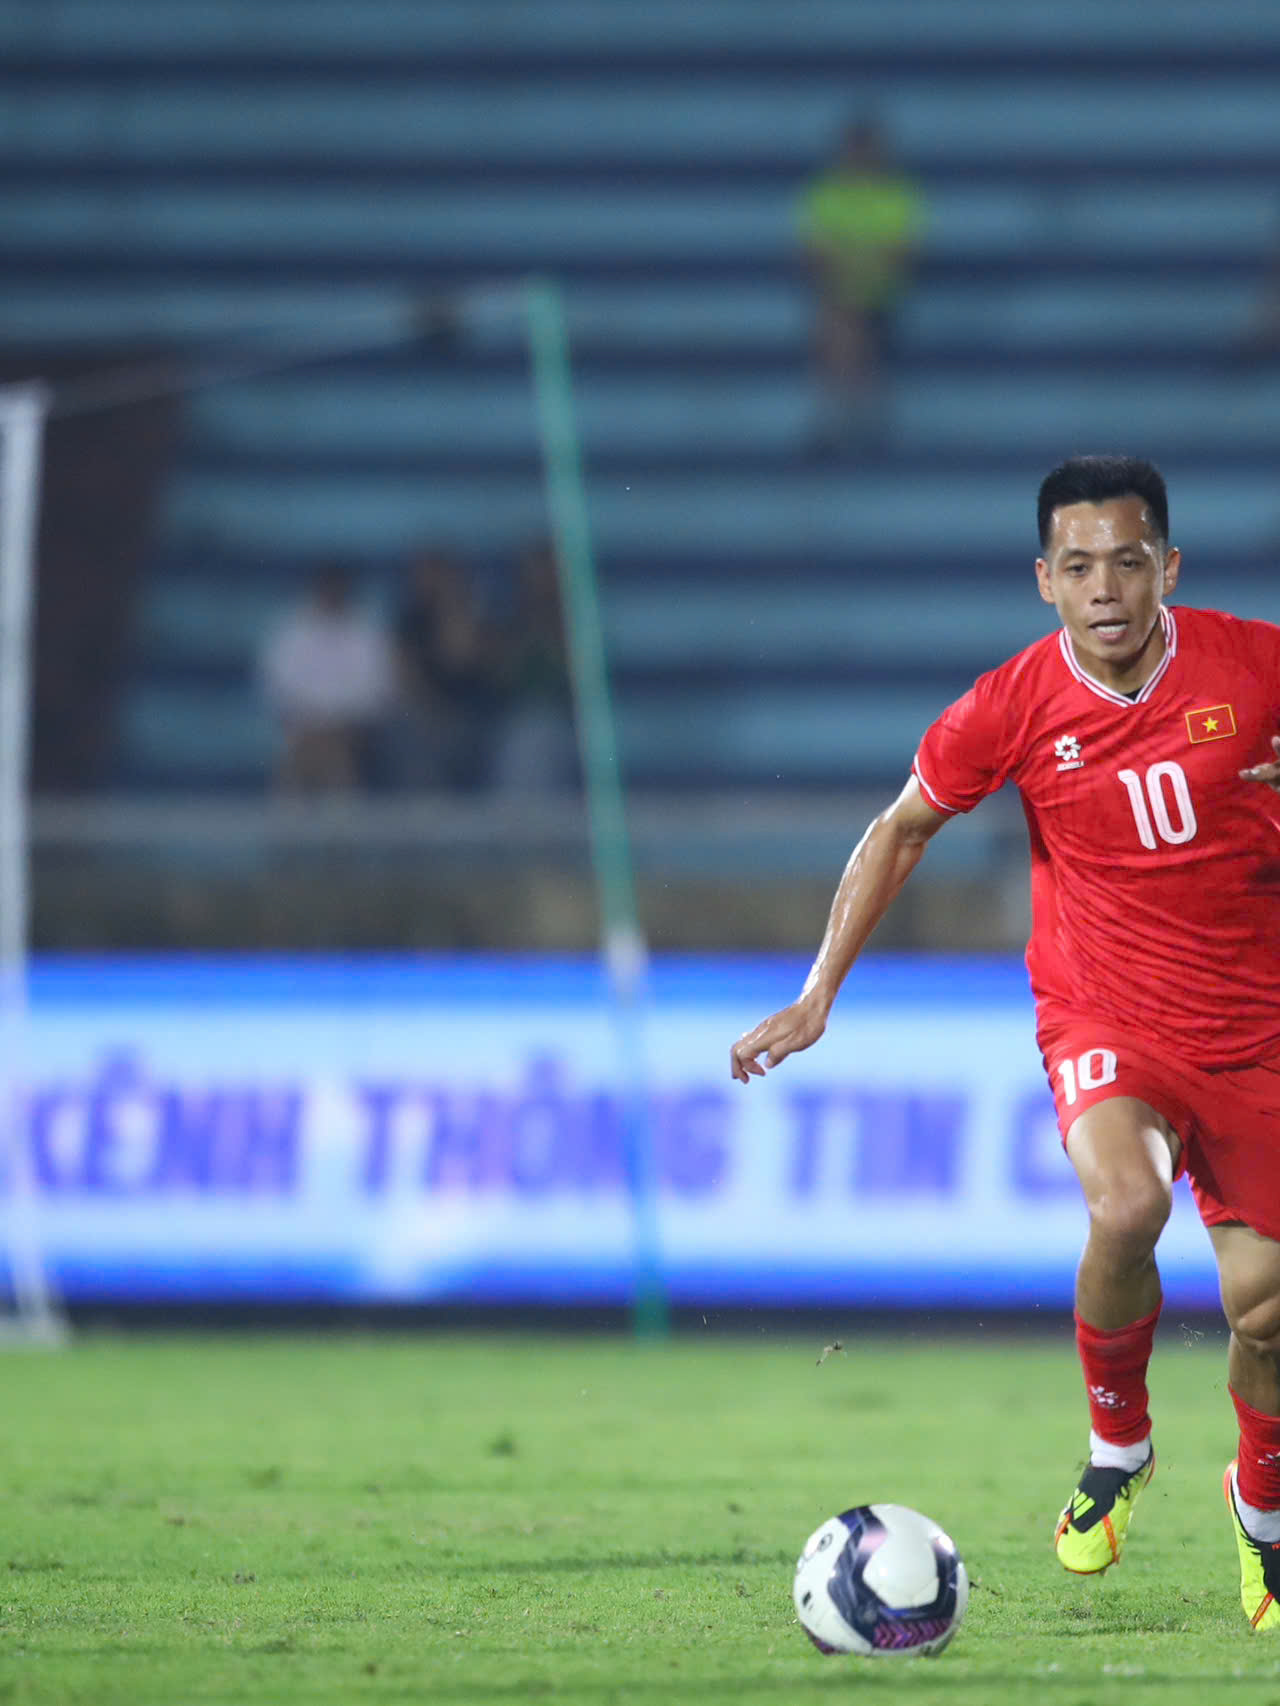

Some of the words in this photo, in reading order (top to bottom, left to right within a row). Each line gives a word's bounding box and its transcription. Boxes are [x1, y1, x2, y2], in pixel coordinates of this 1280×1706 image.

[1117, 760, 1198, 850] 10
[1057, 1048, 1118, 1106] 10
[786, 1083, 970, 1197] TIN
